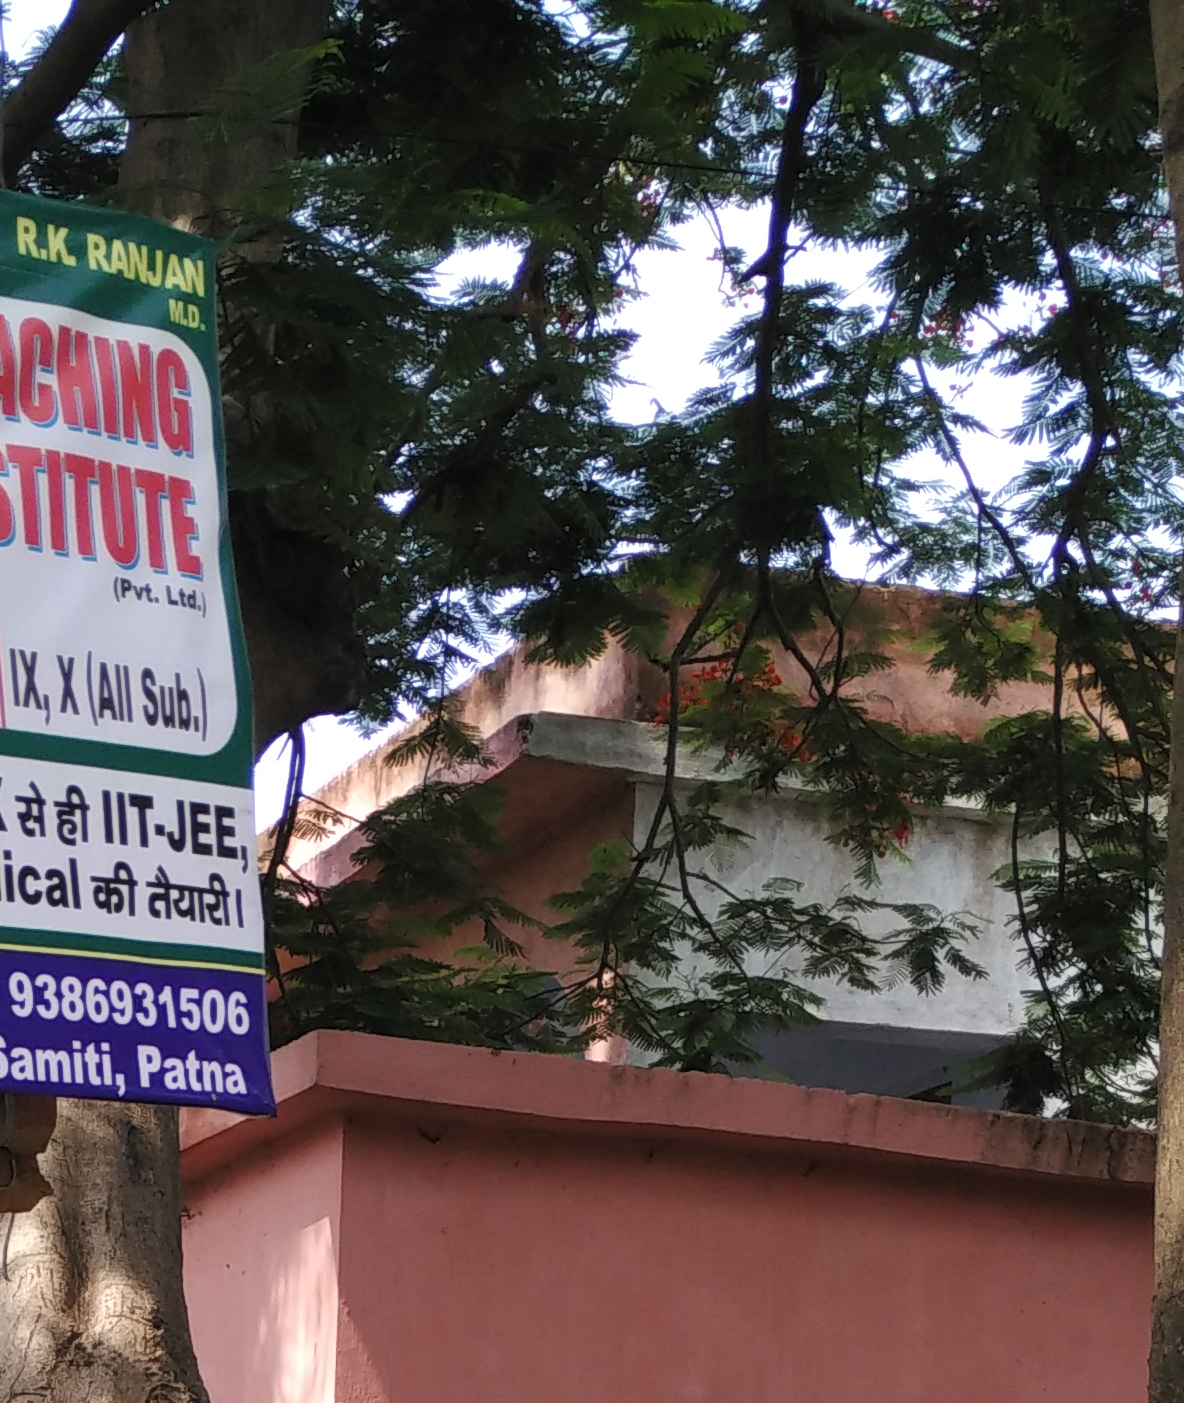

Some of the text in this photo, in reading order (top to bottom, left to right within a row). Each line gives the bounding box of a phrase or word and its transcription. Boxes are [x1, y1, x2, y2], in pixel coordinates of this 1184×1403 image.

[17, 216, 205, 299] R.K. RANJAN
[168, 300, 206, 331] M.D.
[112, 576, 208, 618] (Pvt. Ltd.)
[9, 647, 51, 725] IX,
[59, 655, 81, 715] X
[87, 650, 134, 727] (All
[140, 668, 208, 741] Sub.)
[15, 781, 47, 838] से
[54, 785, 91, 846] ही
[100, 789, 249, 873] IIT-JEE,
[90, 861, 138, 918] की
[8, 970, 251, 1036] 9386931506
[136, 1043, 248, 1096] Patna
